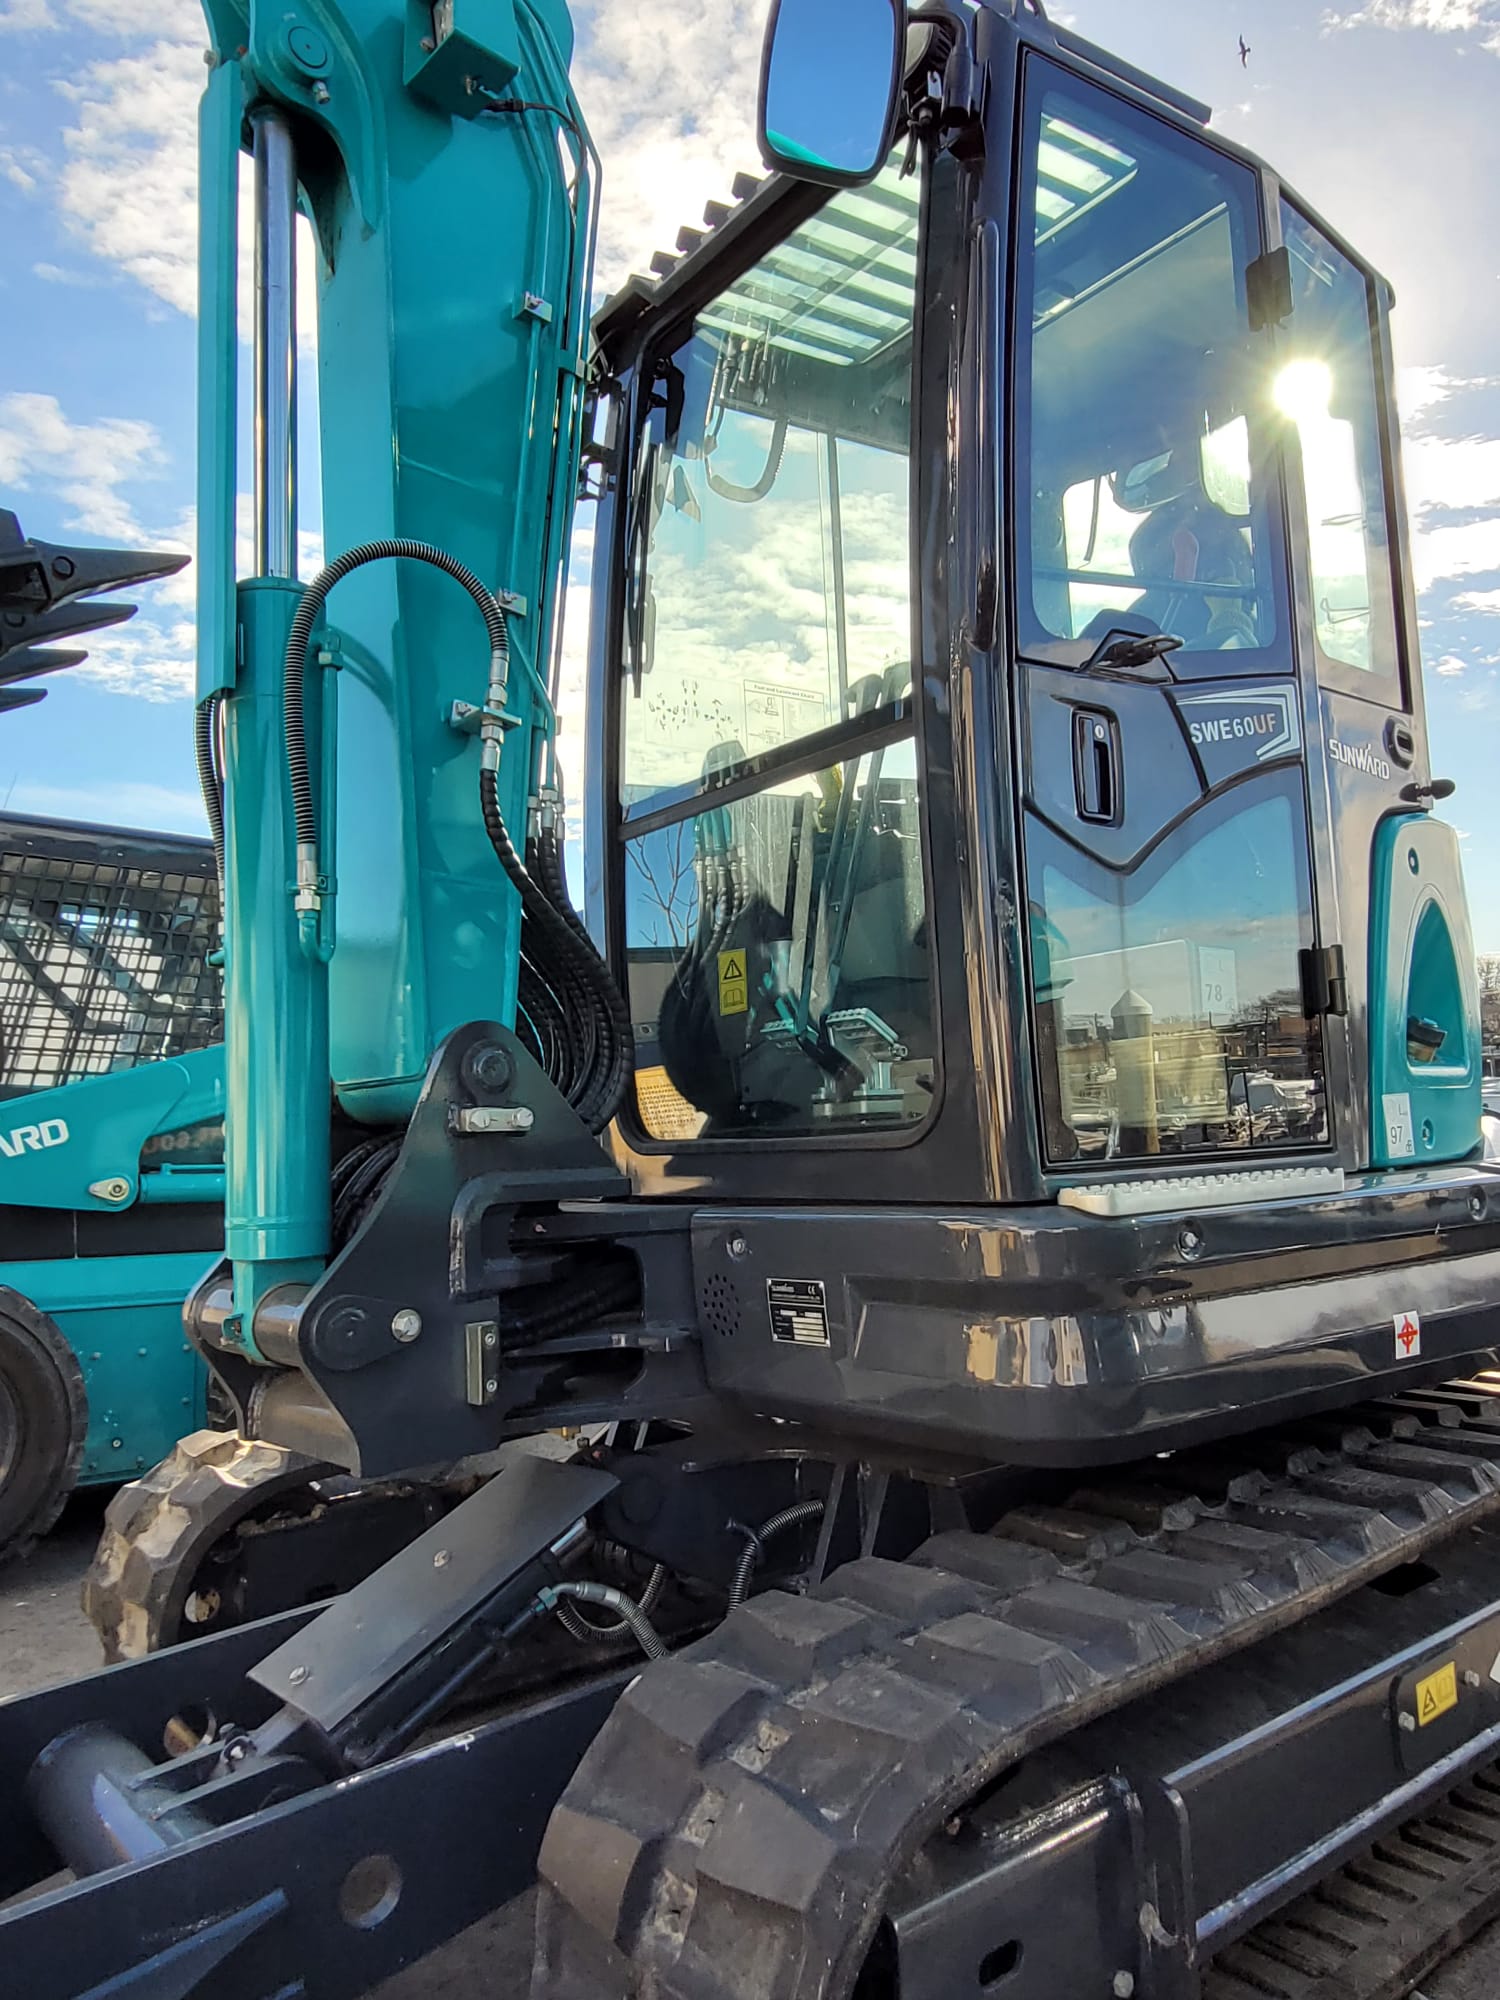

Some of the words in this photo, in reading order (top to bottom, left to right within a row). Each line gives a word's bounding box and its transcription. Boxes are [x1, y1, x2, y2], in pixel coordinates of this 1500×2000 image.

[1190, 713, 1277, 743] SWE60UF
[1328, 738, 1391, 780] SUNWARD
[1205, 983, 1223, 1002] 78
[1390, 1125, 1403, 1145] 97
